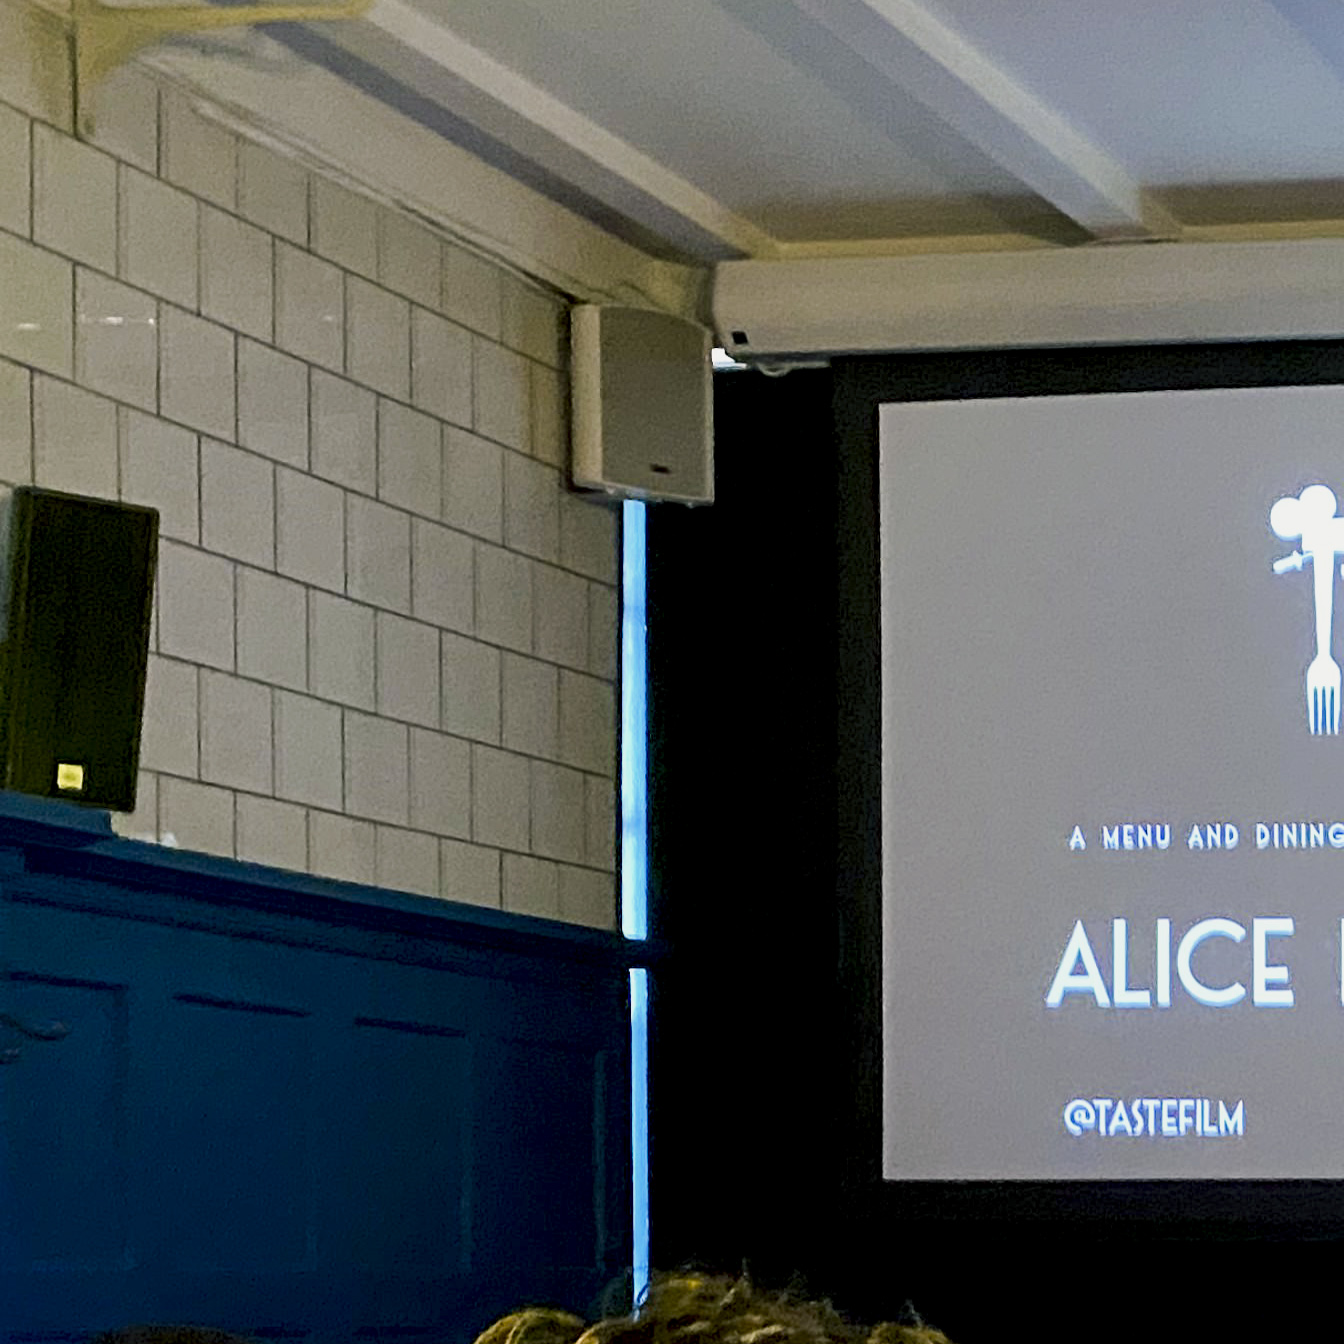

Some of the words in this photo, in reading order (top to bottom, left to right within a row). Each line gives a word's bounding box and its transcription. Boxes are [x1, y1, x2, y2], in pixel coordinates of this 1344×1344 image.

[1068, 825, 1088, 851] A
[1101, 823, 1172, 851] MENU
[1186, 822, 1241, 850] AND
[1044, 917, 1295, 1009] ALICE
[1063, 1098, 1247, 1137] @TASTEFILM
